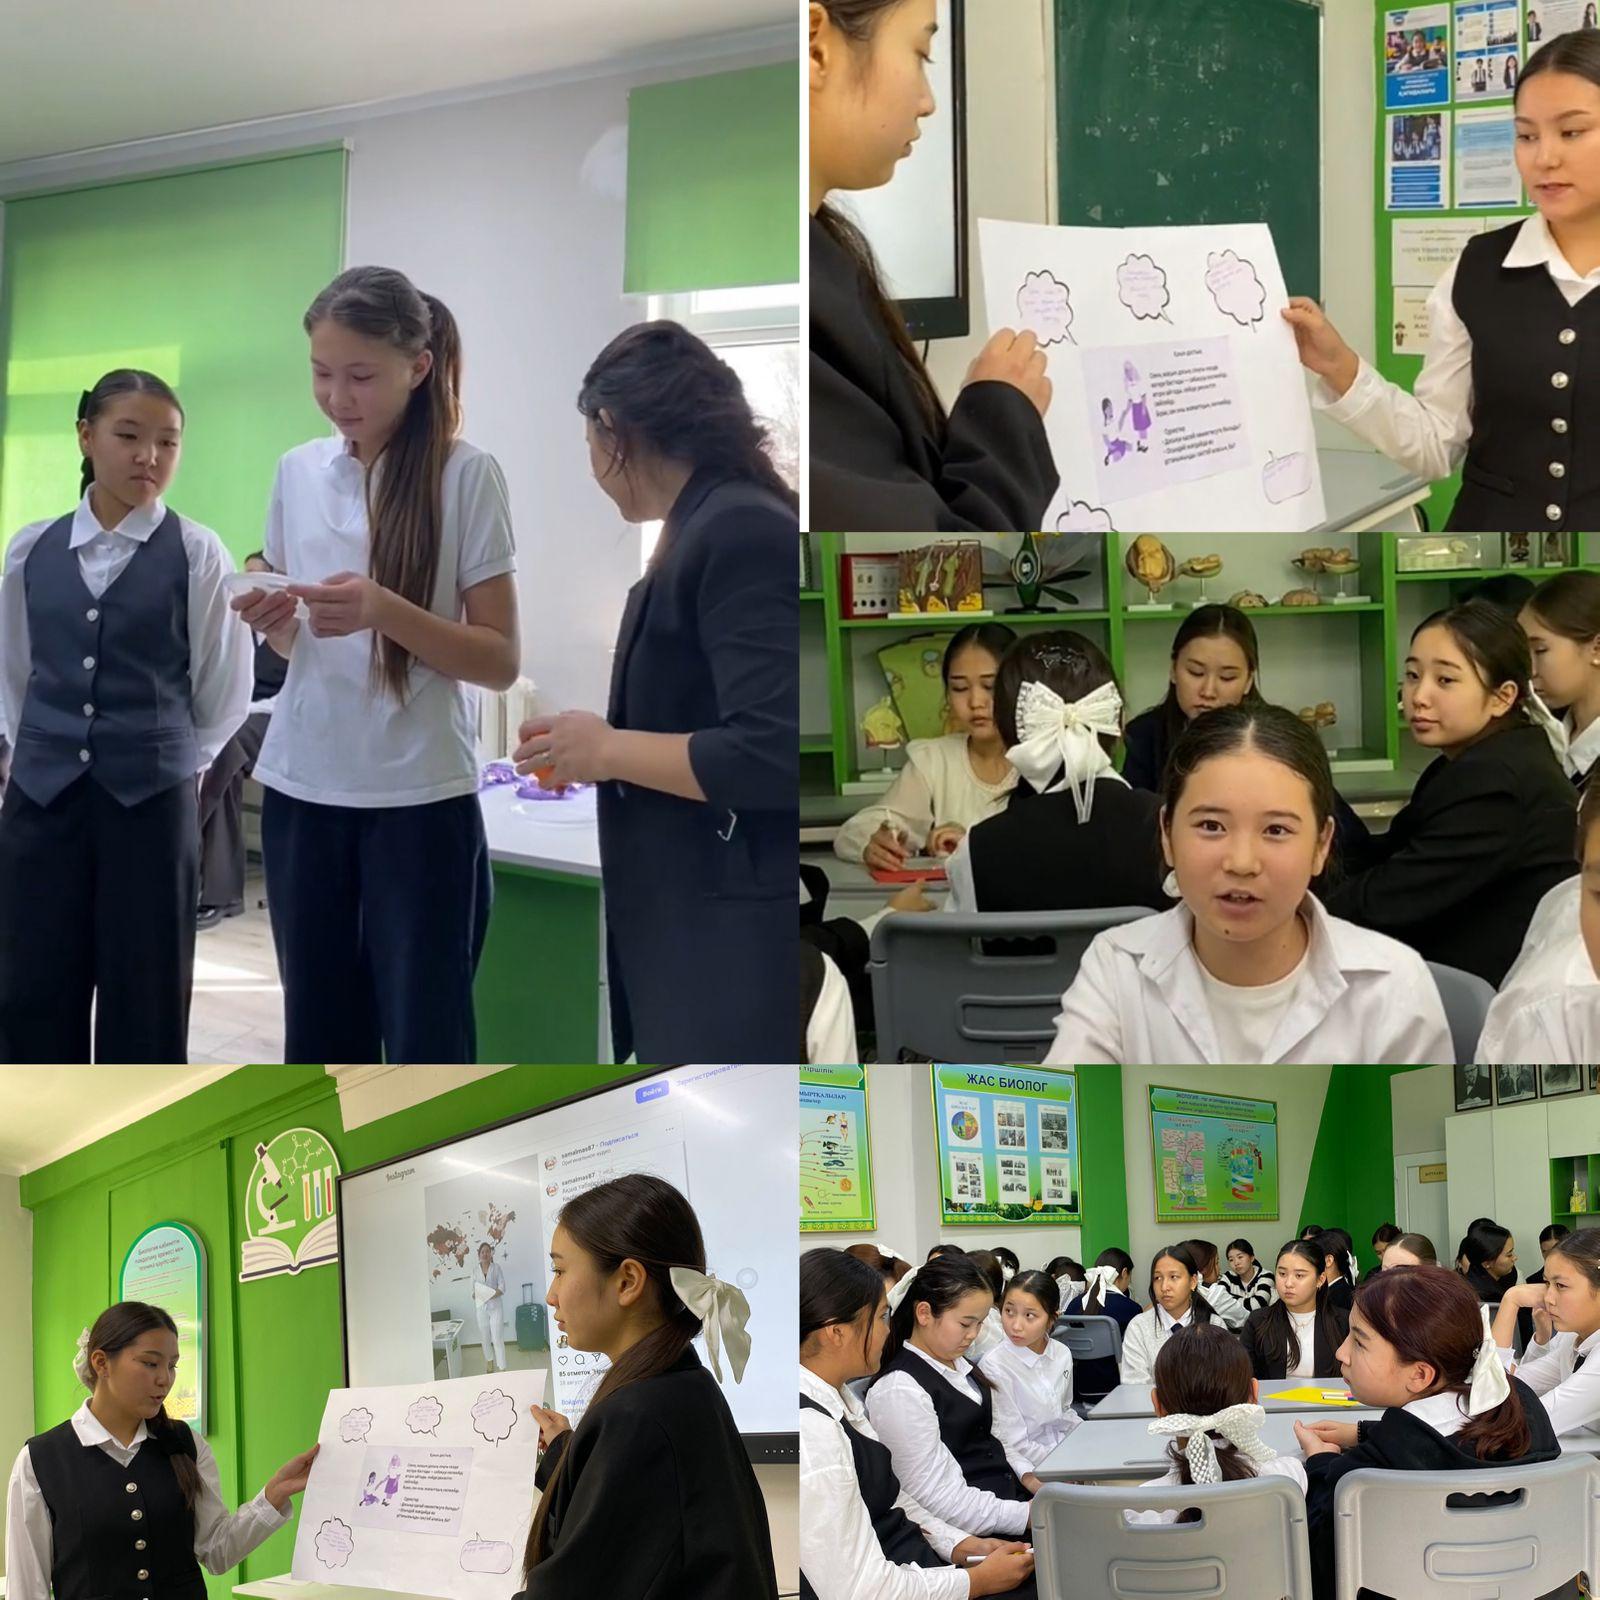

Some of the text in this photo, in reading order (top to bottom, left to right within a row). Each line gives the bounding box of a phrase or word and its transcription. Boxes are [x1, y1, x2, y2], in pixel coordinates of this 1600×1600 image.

[966, 1073, 1048, 1092] ЖАС БИОЛОГ
[600, 1132, 639, 1148] Подписаться
[385, 1167, 416, 1182] Instagram
